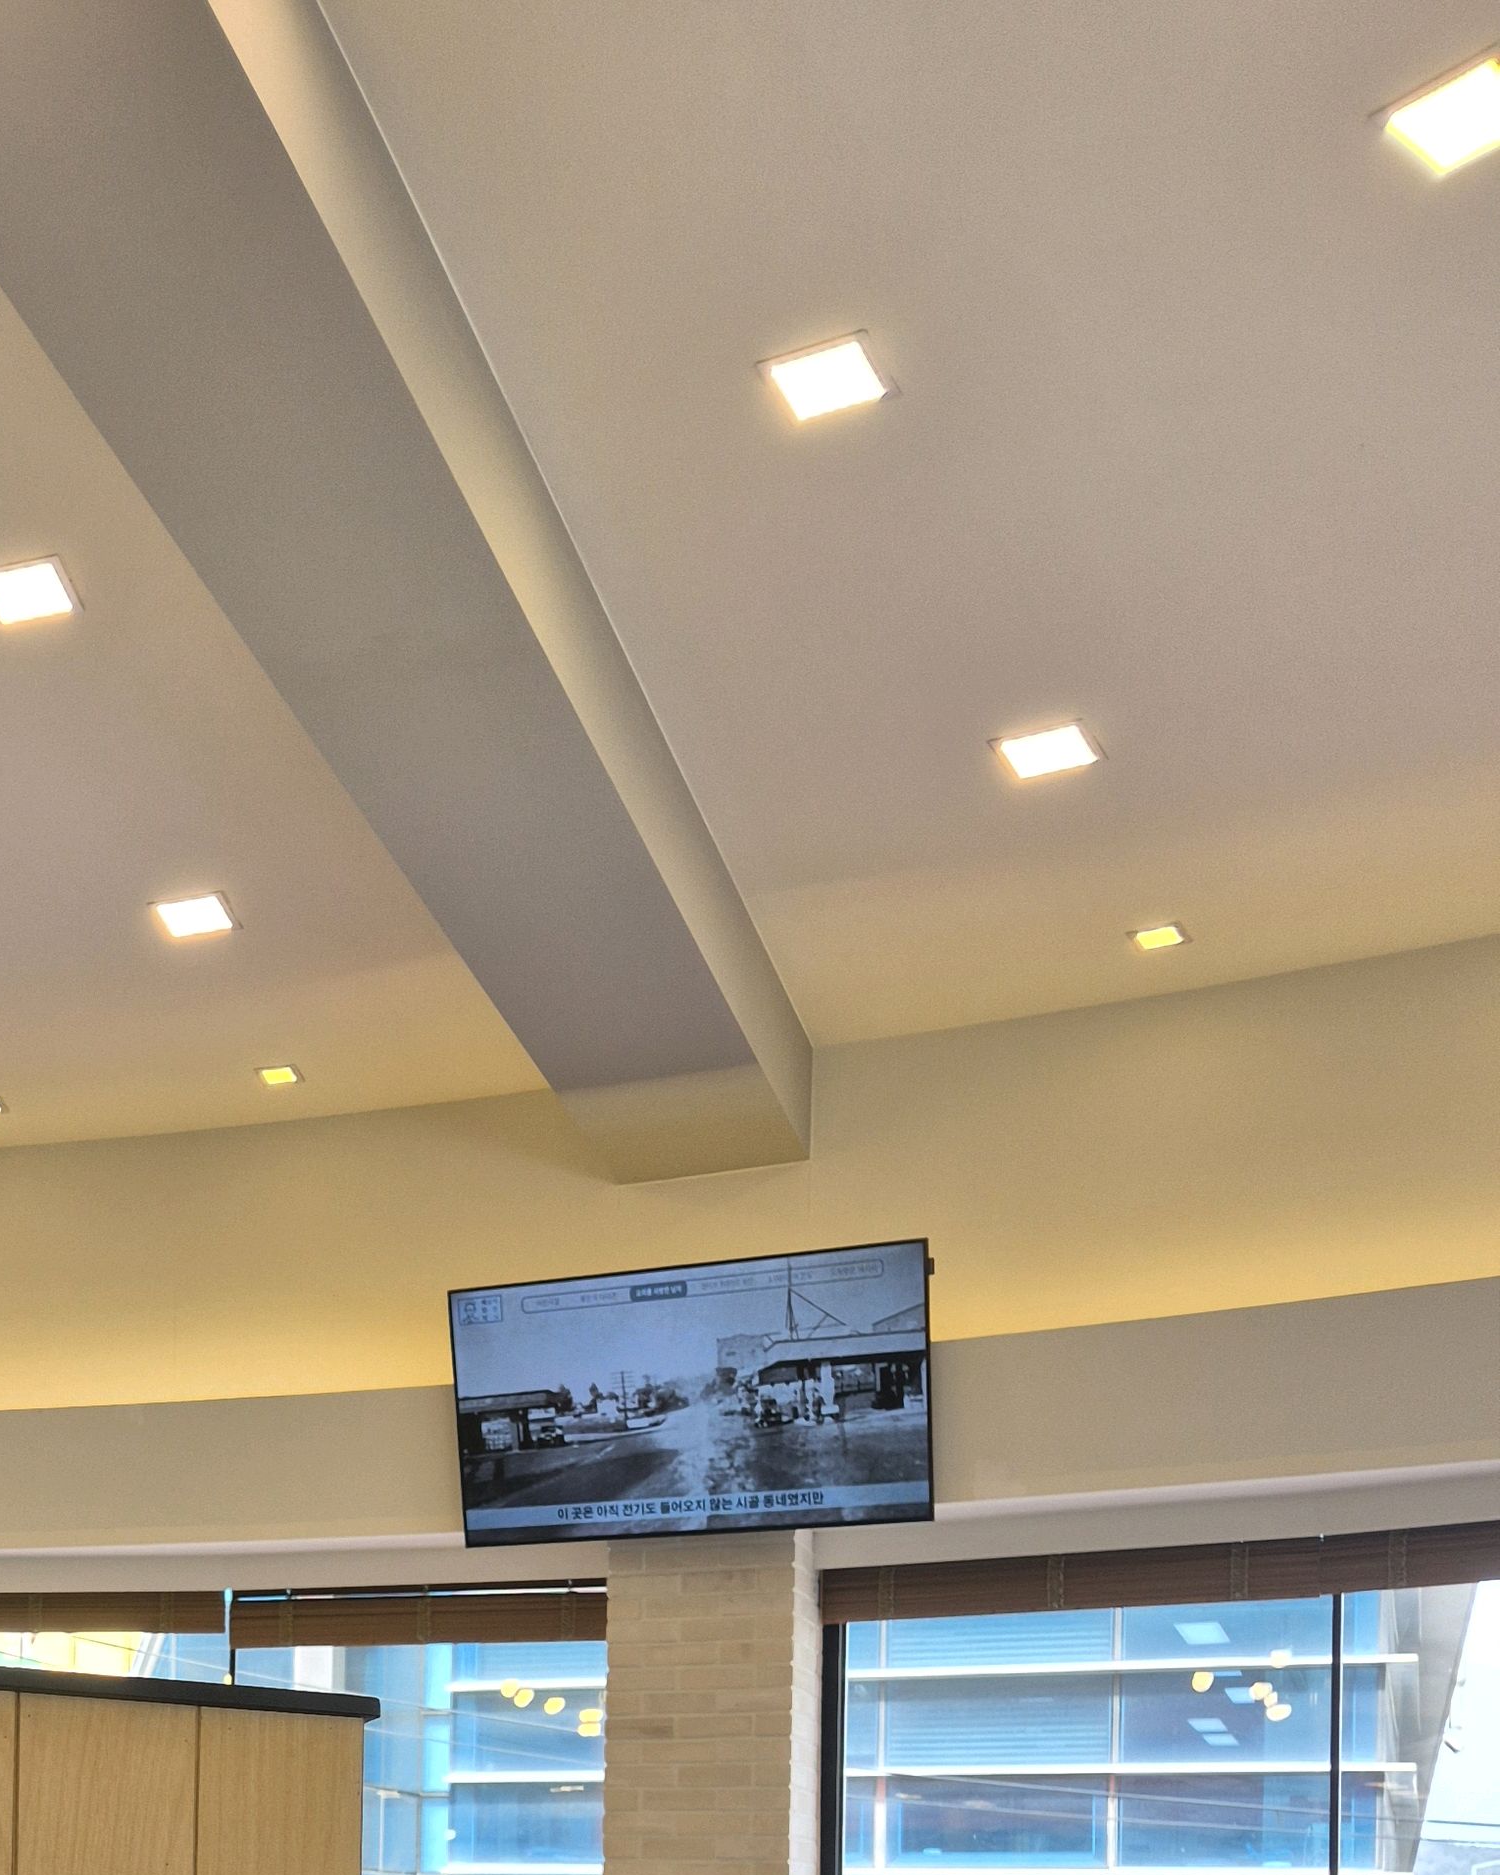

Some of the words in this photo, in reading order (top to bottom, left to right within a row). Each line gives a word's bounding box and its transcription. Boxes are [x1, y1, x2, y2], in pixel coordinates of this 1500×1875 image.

[557, 1507, 569, 1520] 이
[571, 1506, 594, 1520] 곳은
[596, 1504, 619, 1518] 아직
[622, 1502, 657, 1516] 전기도
